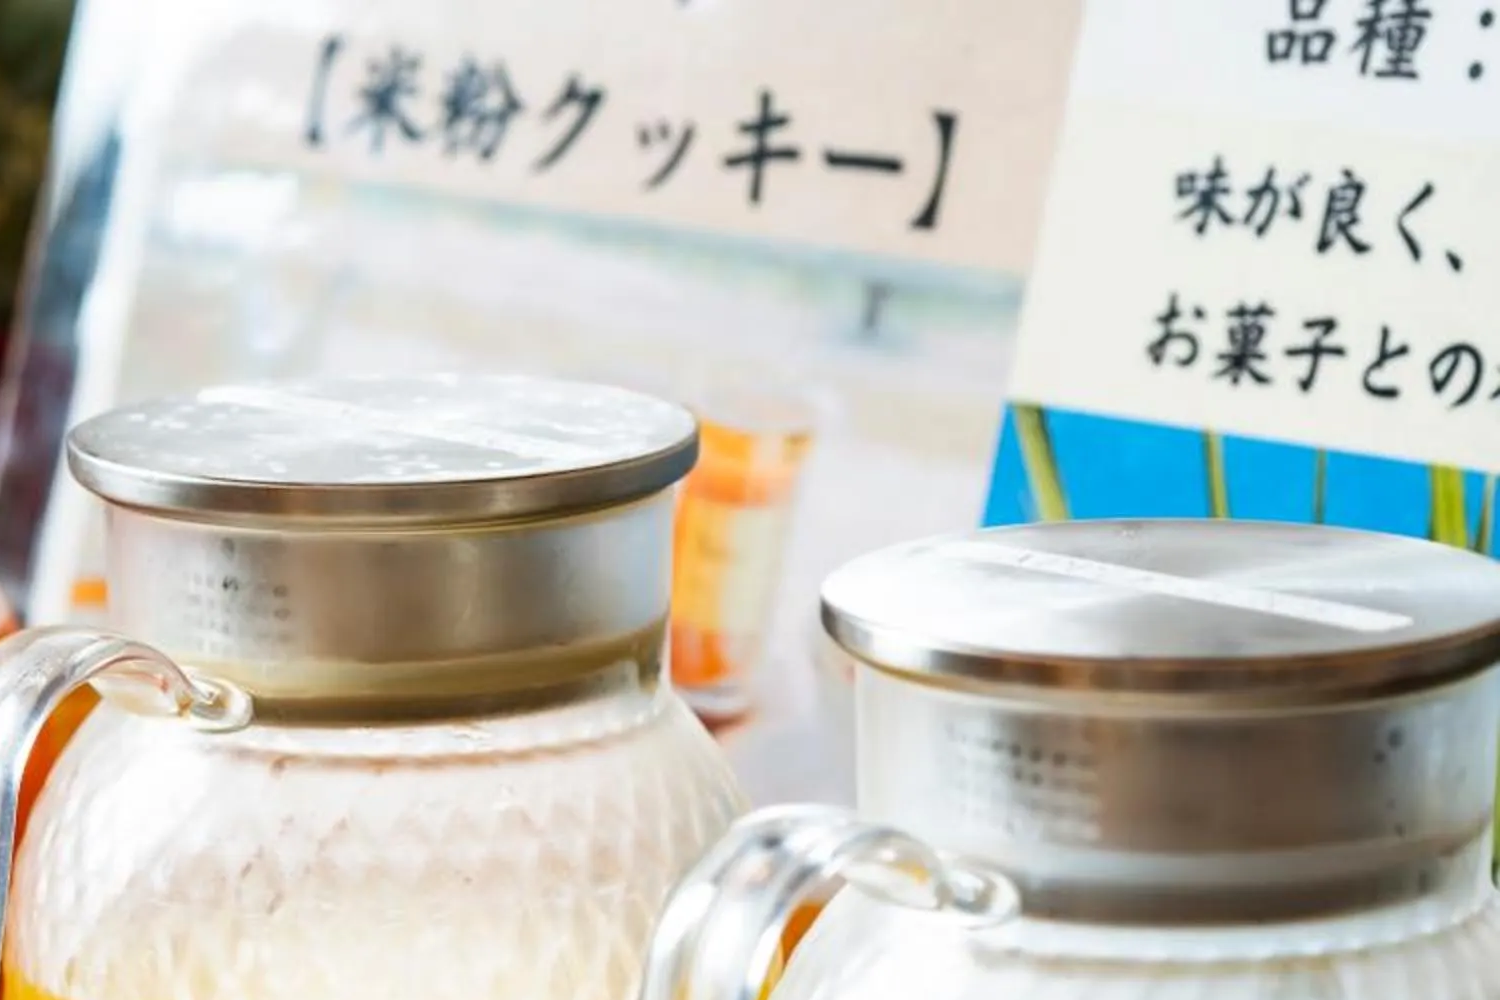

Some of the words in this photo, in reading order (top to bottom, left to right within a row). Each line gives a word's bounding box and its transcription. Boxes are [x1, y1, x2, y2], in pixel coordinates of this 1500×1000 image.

[1174, 155, 1465, 274] 味が良く、
[1145, 293, 1500, 409] お菓子との
